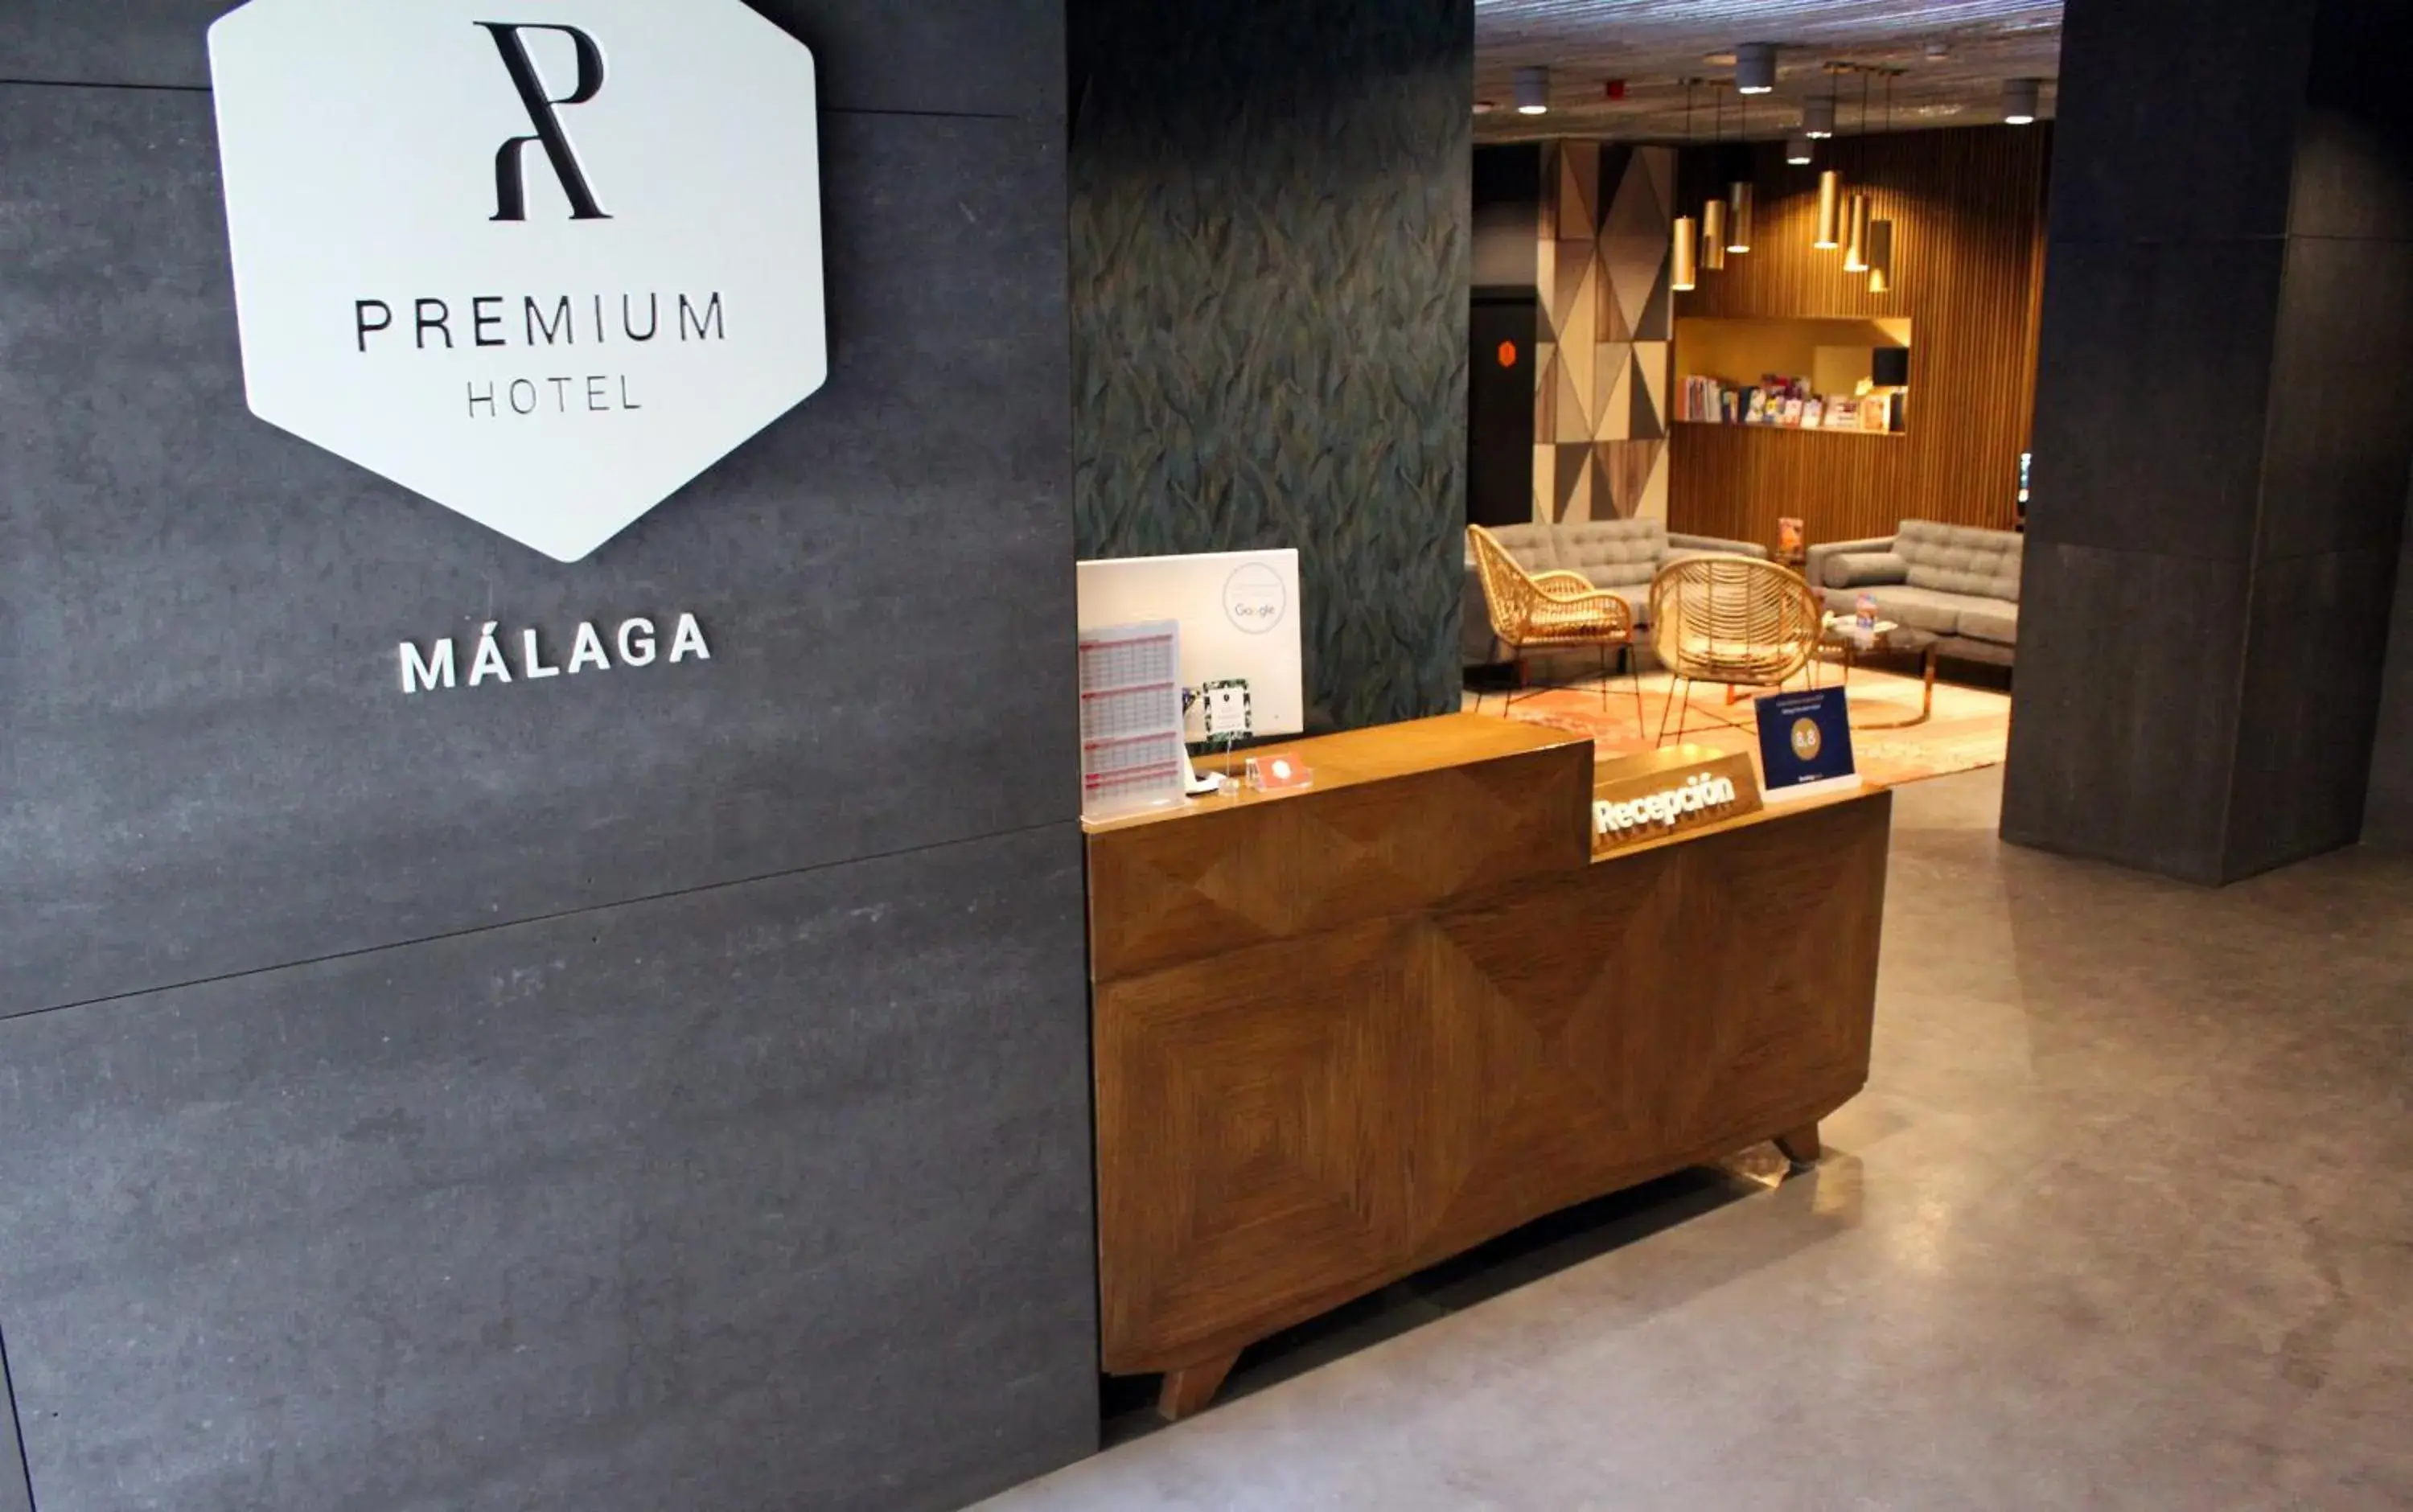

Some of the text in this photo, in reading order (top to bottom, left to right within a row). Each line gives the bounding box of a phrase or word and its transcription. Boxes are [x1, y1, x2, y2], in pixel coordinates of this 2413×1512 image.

[354, 292, 726, 352] PREMIUM
[467, 375, 643, 418] HOTEL
[397, 613, 711, 693] MÁLAGA
[1593, 772, 1735, 833] Recepción
